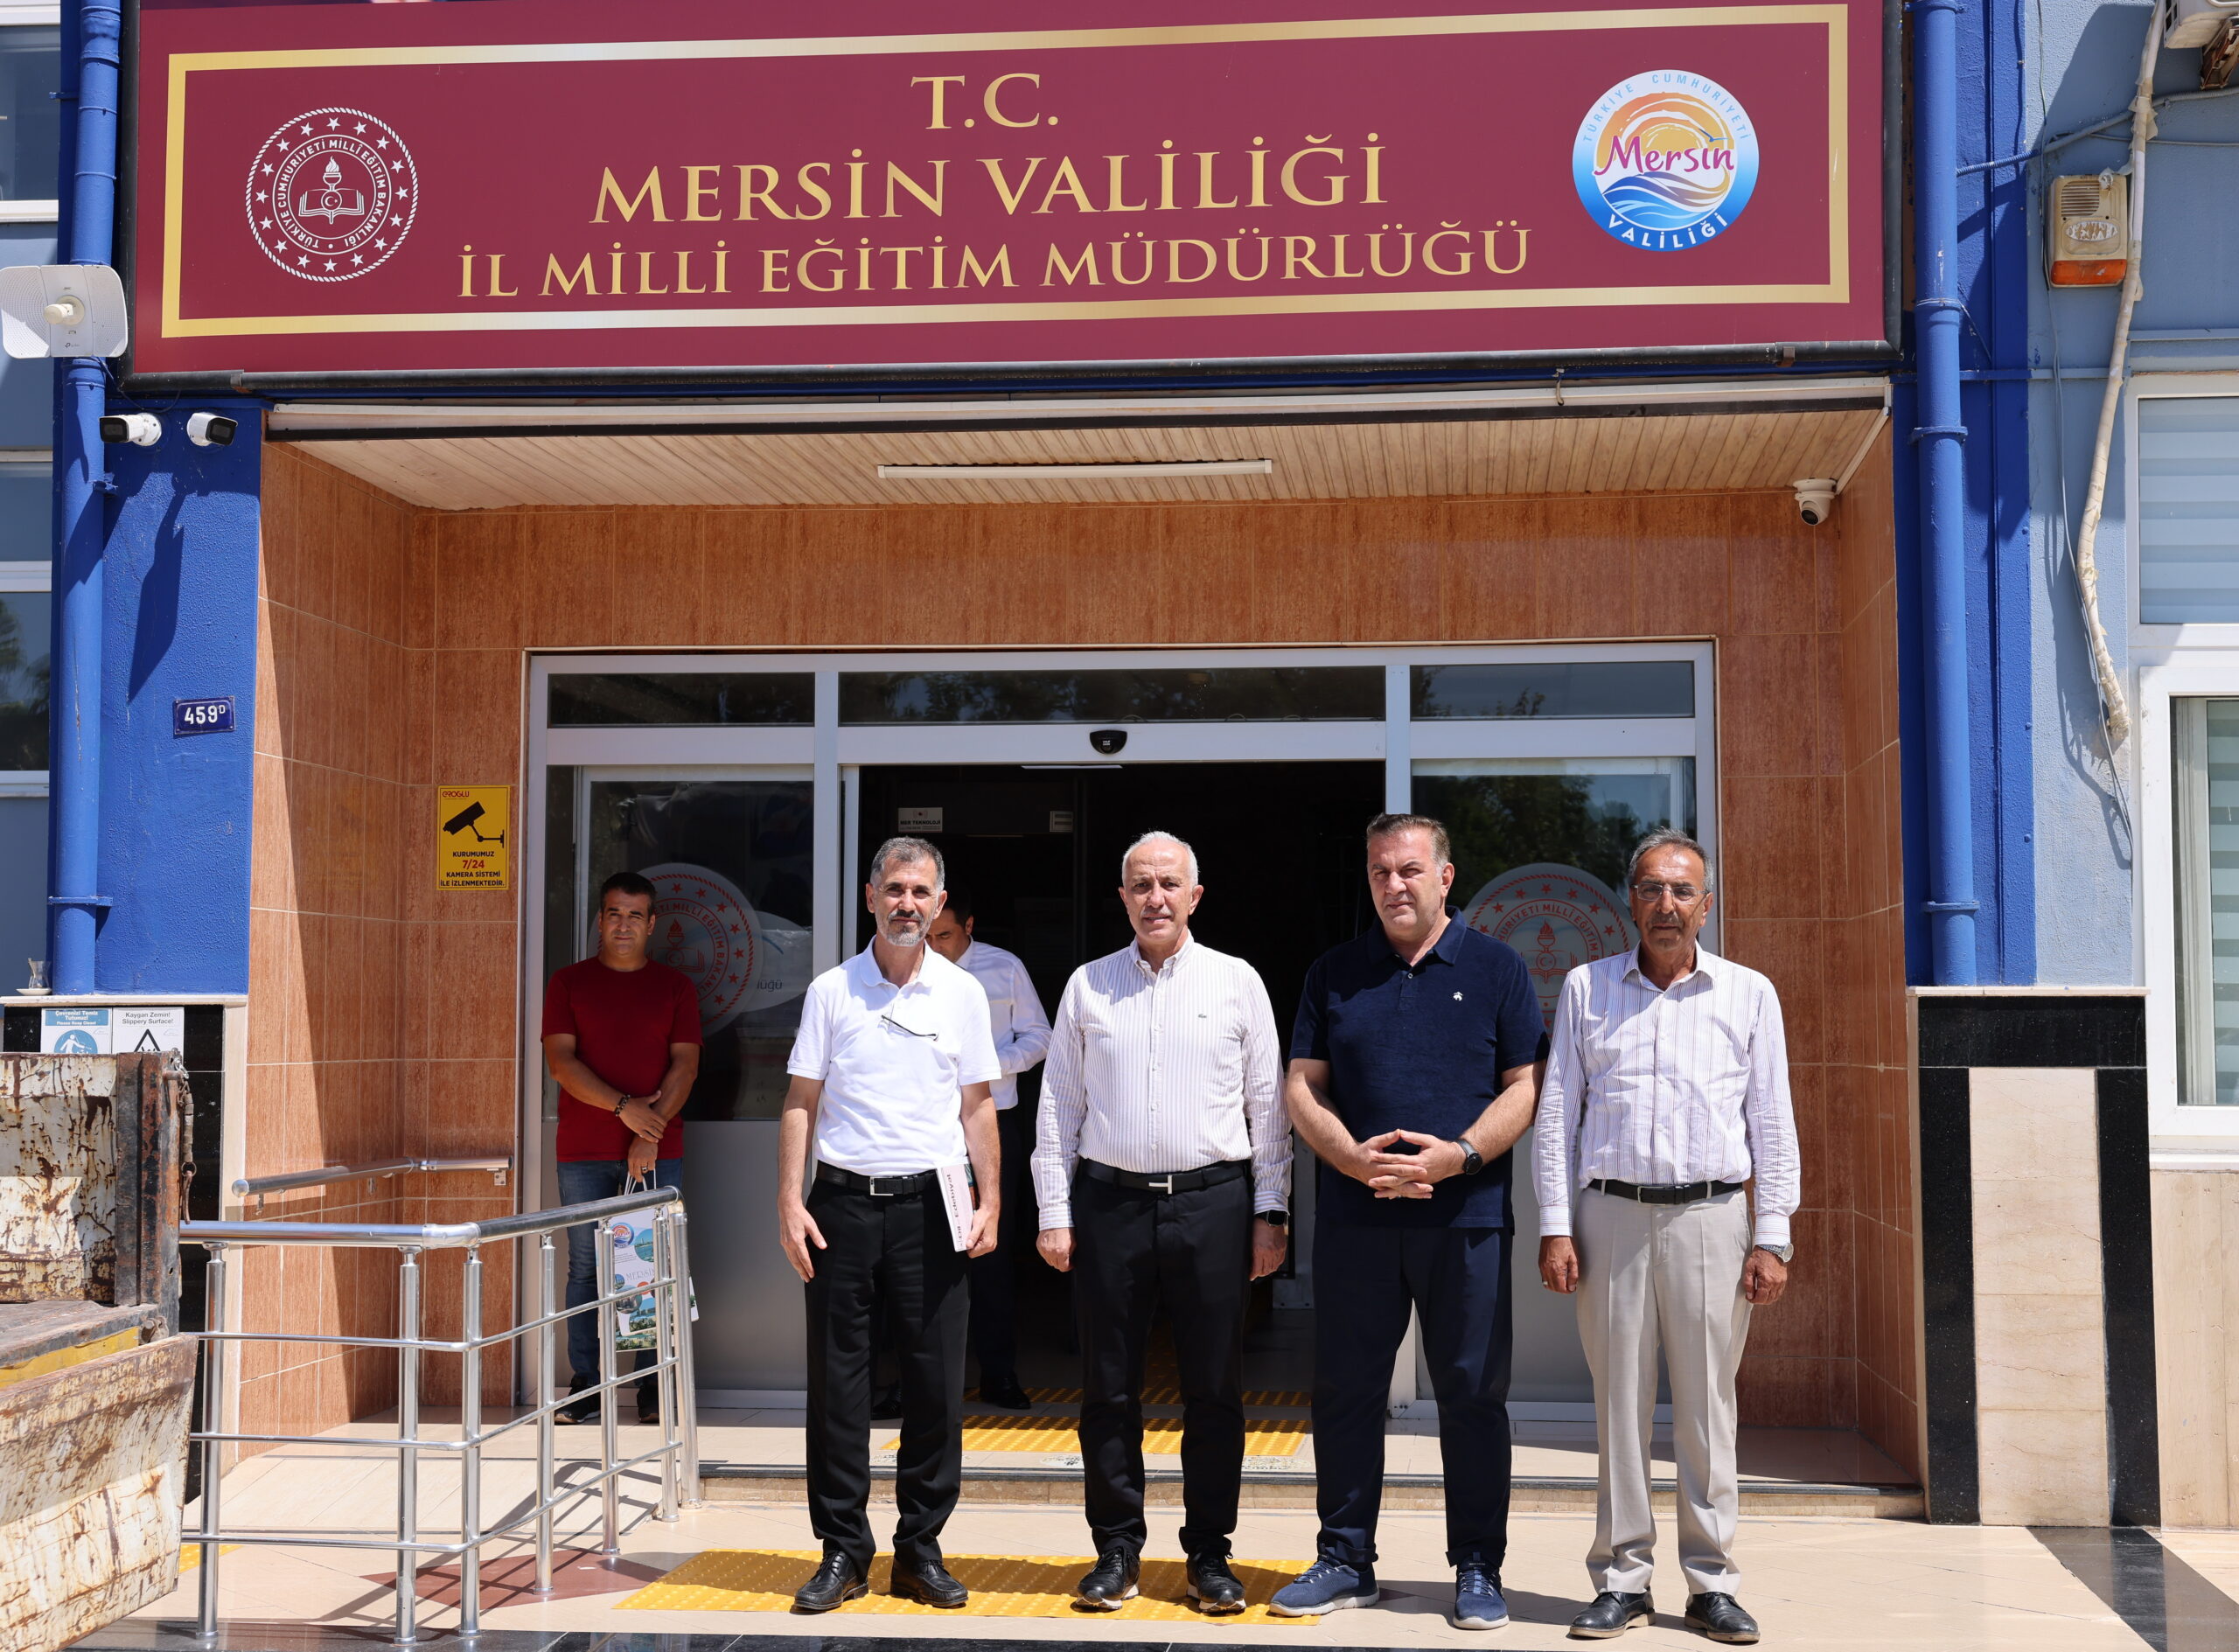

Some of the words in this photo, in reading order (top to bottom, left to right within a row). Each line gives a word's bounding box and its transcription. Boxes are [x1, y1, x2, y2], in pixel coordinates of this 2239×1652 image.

[910, 73, 1059, 129] T.C.
[1583, 83, 1634, 143] TÜRKİYE
[1651, 73, 1752, 140] CUMHURİYETİ
[277, 138, 326, 208] CUMHURİYETİ
[360, 150, 387, 189] EĞİTİM
[589, 148, 951, 224] MERSİN
[975, 132, 1389, 216] VALİLİĞİ
[280, 210, 320, 248] TÜRKİYE
[344, 192, 387, 247] BAKANLIĞI
[1608, 212, 1728, 249] VALİLİĞİ
[457, 244, 519, 297] İL
[538, 240, 732, 296] MİLLİ
[758, 235, 1020, 293] EĞİTİM
[1040, 220, 1531, 287] MÜDÜRLÜĞÜ
[462, 859, 485, 869] 7/24
